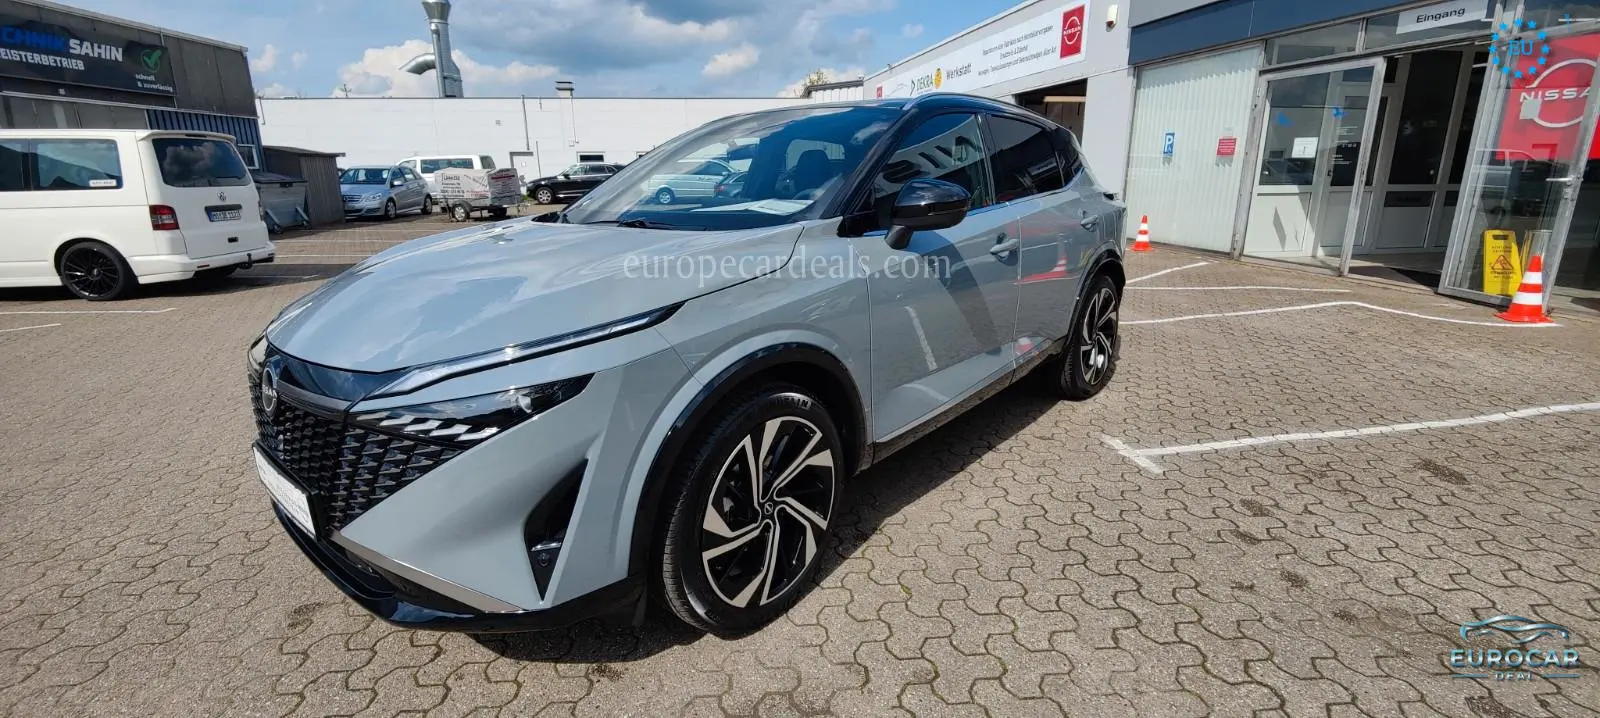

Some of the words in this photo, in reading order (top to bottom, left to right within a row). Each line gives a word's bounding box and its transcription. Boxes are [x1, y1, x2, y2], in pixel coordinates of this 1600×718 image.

[1416, 6, 1466, 23] Eingang
[1063, 25, 1082, 36] NISSAN
[69, 38, 123, 62] SAHIN
[0, 47, 85, 71] EISTERBETRIEB
[916, 73, 934, 89] DEKRA
[1519, 87, 1592, 103] NISSA
